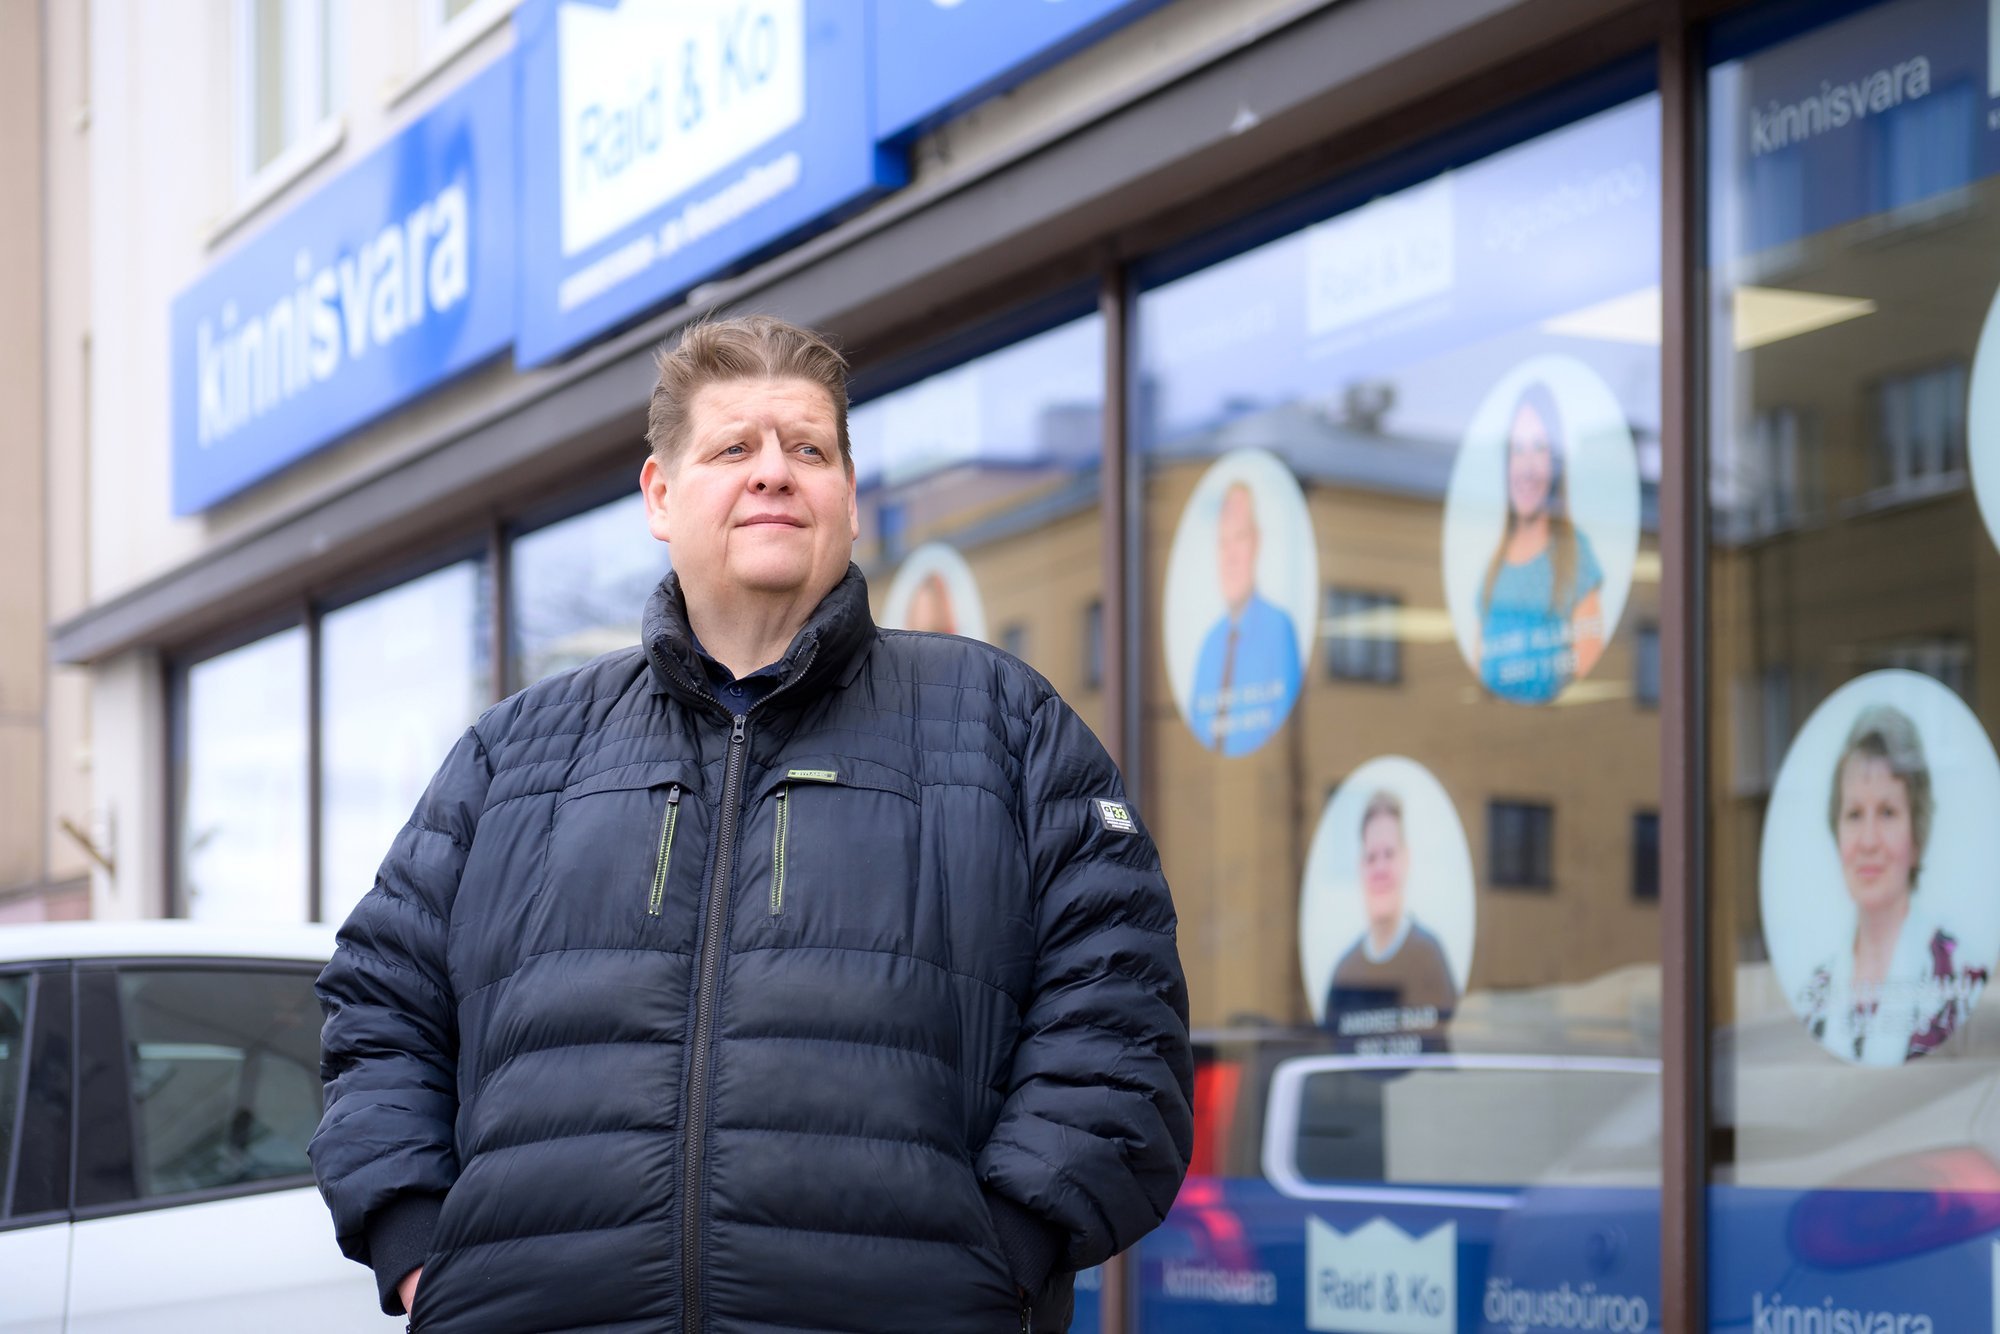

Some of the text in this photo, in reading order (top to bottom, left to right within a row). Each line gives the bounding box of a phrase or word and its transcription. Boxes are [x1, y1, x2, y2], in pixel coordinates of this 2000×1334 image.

[576, 2, 780, 190] Raid & Ko
[1752, 55, 1931, 156] kinnisvara
[197, 185, 469, 448] kinnisvara
[1162, 1258, 1277, 1304] kinnisvara
[1318, 1267, 1446, 1318] Raid & Ko
[1483, 1277, 1649, 1334] õigusbüroo
[1753, 1290, 1933, 1334] kinnisvara
